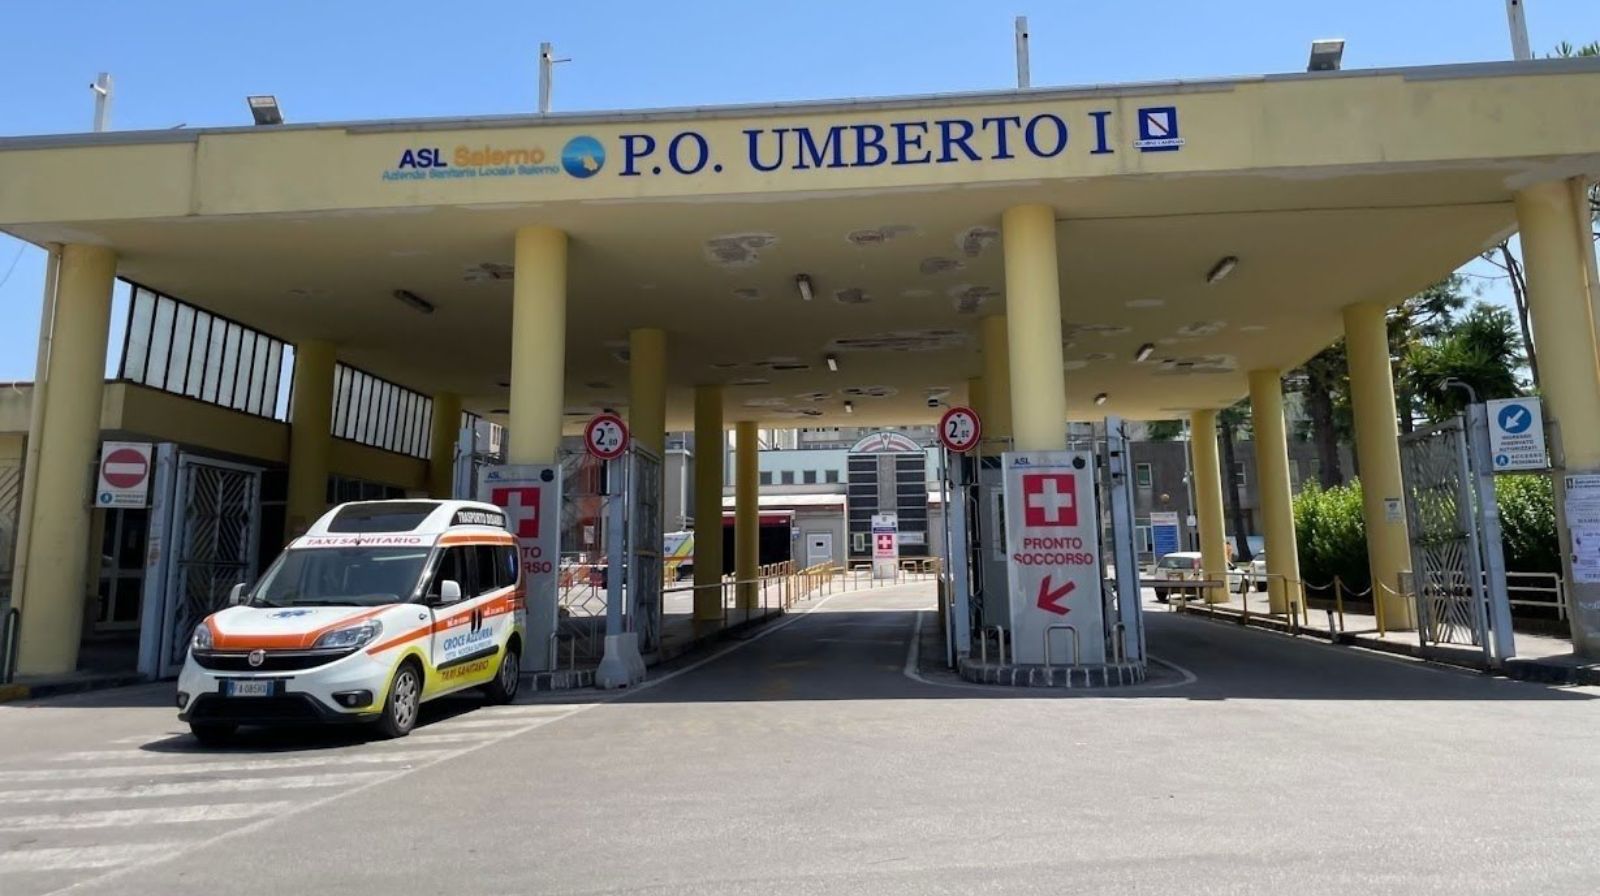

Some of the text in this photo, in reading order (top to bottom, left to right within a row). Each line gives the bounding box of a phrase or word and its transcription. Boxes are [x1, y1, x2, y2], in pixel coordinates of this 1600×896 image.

[619, 111, 1114, 177] P.O. UMBERTO I
[398, 145, 545, 169] ASL Salerno
[382, 164, 560, 181] Azienda Sanitaria Locale Salerno
[595, 428, 605, 445] 2
[948, 421, 958, 438] 2
[1013, 457, 1031, 465] ASL
[457, 511, 486, 524] TRASPORTO
[306, 536, 422, 546] TAXI SANITARIO
[1023, 537, 1083, 550] PRONTO
[1013, 552, 1094, 566] SOCCORSO
[444, 636, 465, 651] CROCE
[466, 626, 493, 642] AZZURRA
